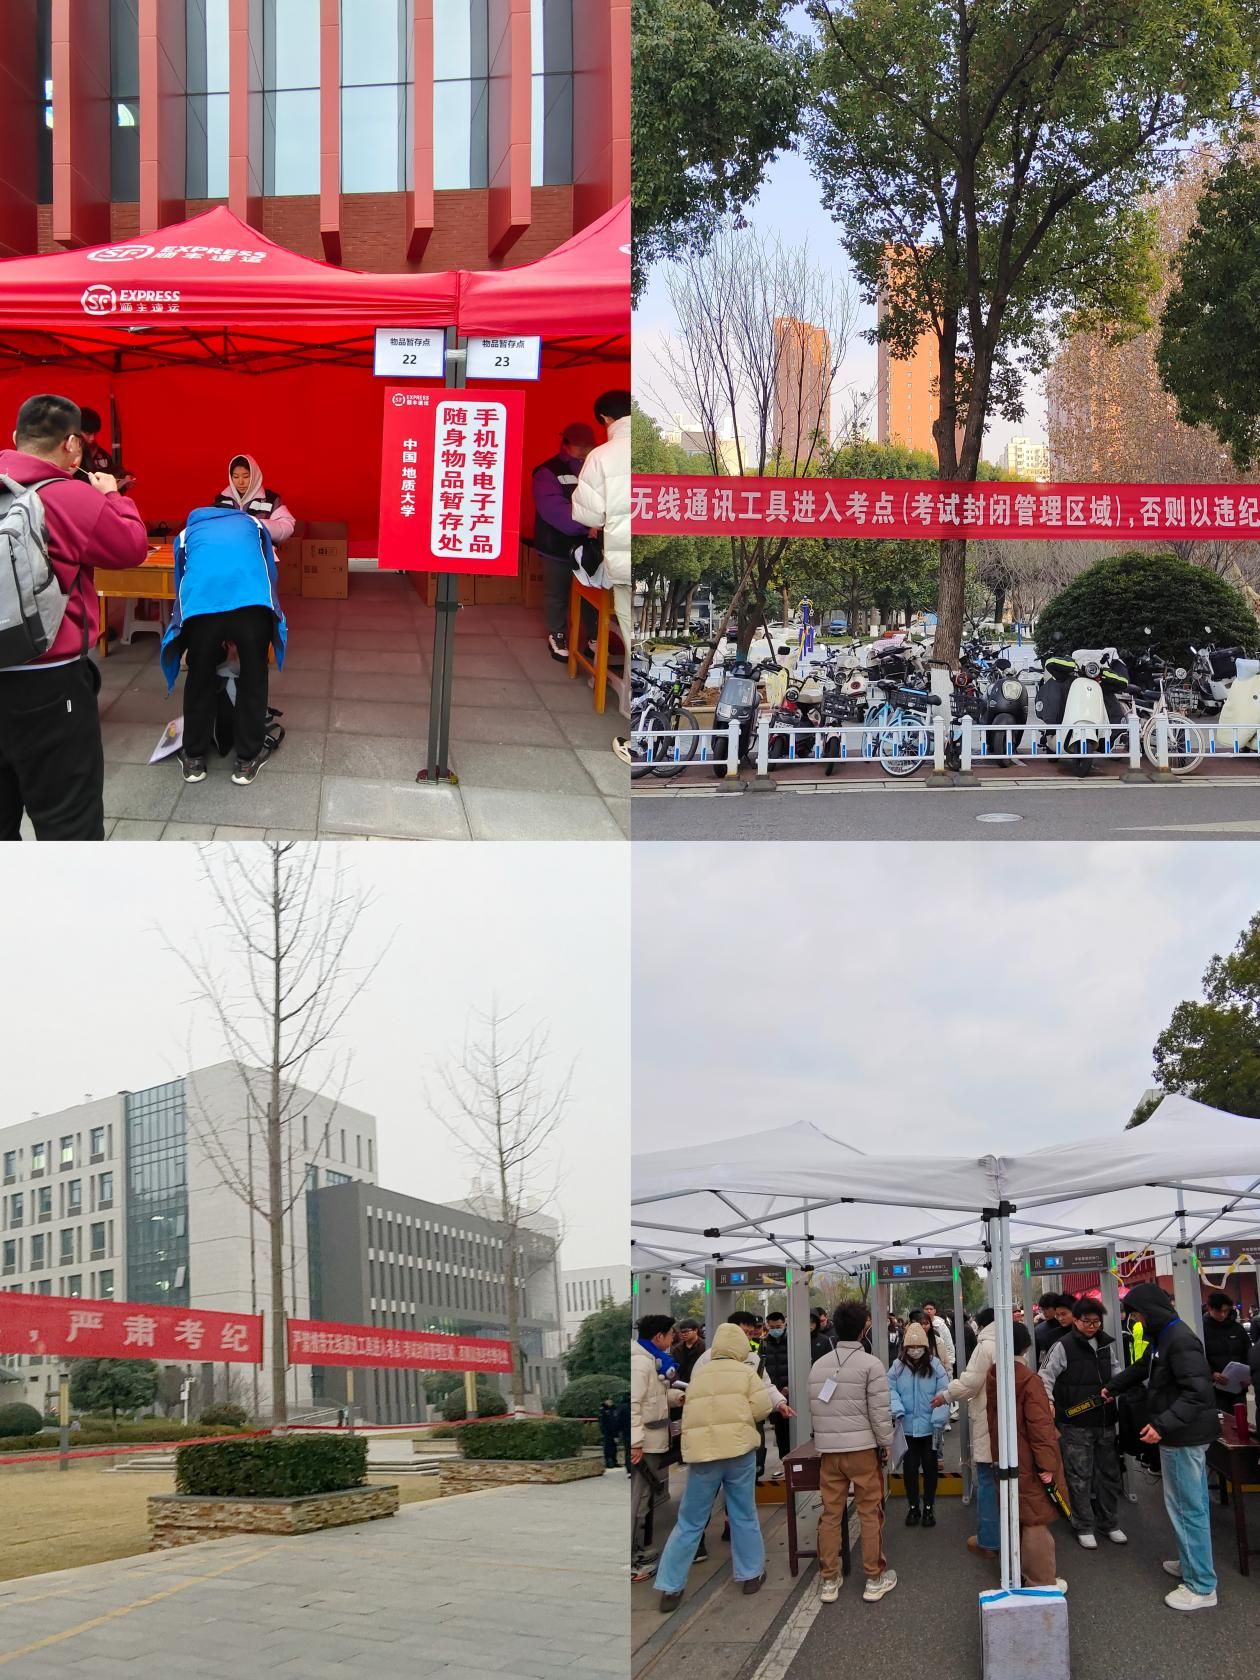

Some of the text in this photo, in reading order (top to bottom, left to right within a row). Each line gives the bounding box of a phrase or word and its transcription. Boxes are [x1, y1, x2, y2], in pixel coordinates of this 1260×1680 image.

[159, 245, 267, 259] EXPRESS
[119, 289, 181, 302] EXPRESS
[390, 337, 431, 347] 物品暂存点
[482, 339, 525, 349] 物品暂存点
[402, 354, 417, 365] 22
[494, 356, 510, 367] 23
[438, 407, 469, 552] 随身物品暂存处
[469, 408, 500, 553] 手机等电子产品
